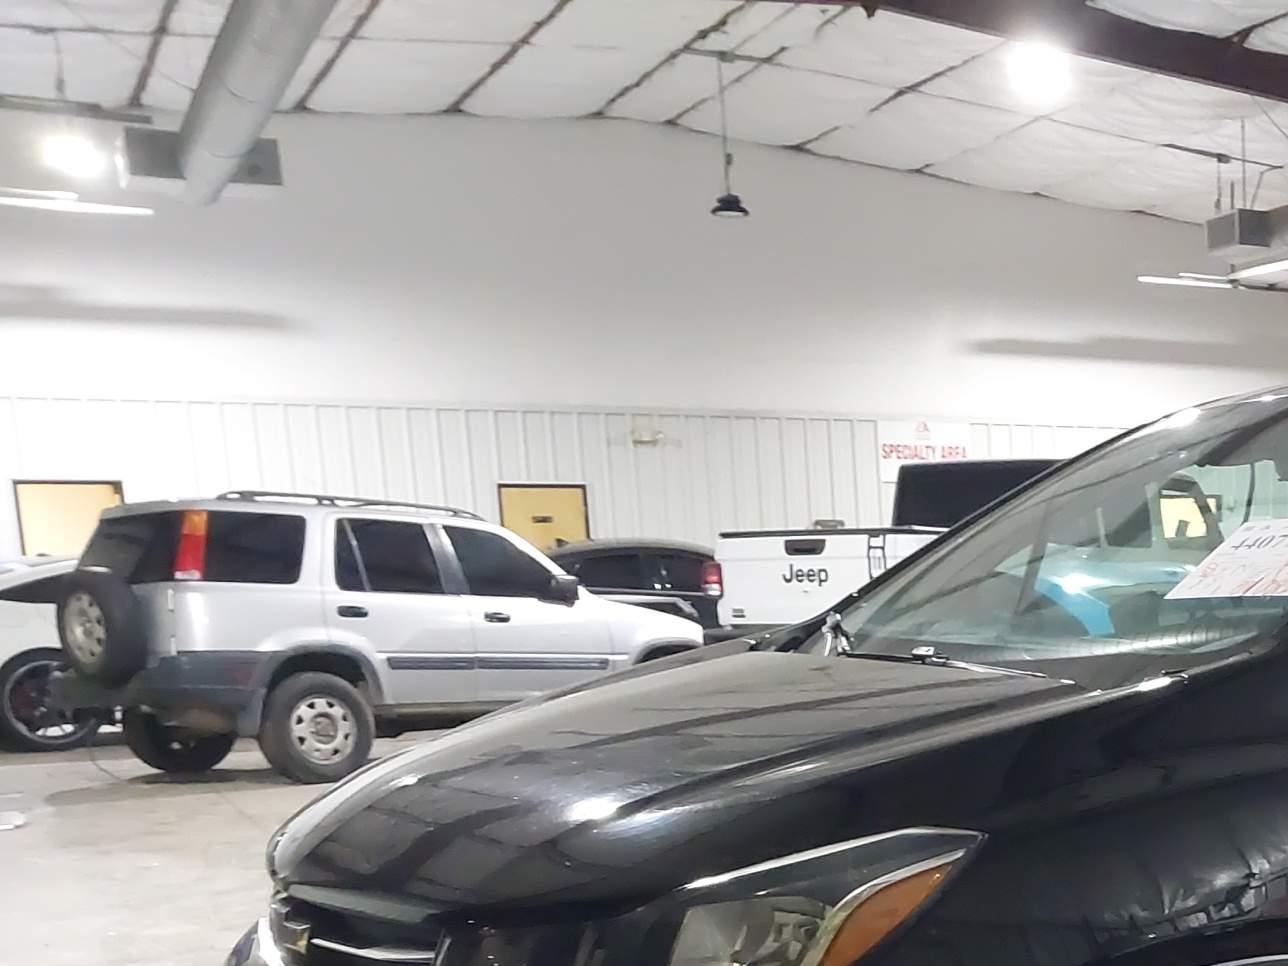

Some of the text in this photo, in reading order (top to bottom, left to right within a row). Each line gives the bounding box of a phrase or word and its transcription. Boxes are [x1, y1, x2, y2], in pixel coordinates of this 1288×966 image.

[881, 443, 967, 460] SPECIALTY AREA
[782, 563, 829, 587] Jeep
